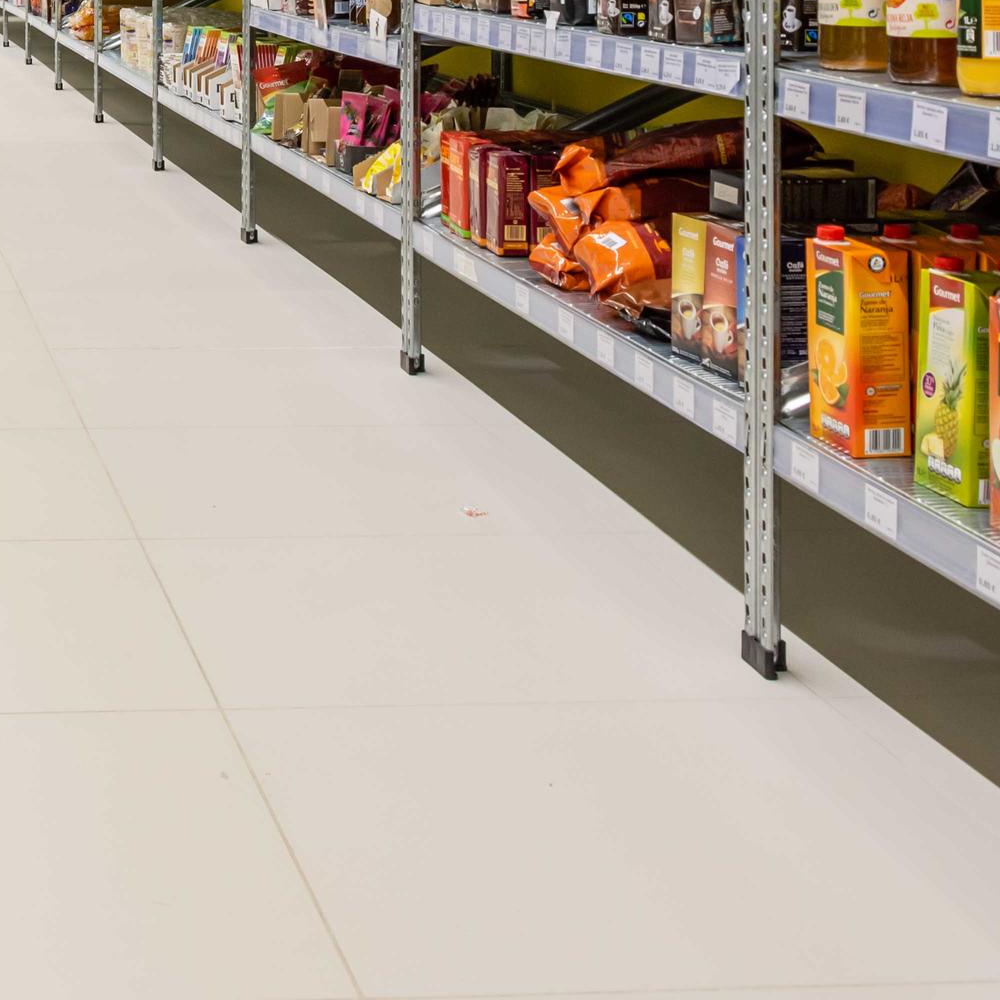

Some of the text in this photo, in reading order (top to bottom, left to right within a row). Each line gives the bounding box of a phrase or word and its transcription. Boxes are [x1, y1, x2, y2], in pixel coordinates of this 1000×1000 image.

[259, 78, 290, 90] Gourmet
[712, 235, 735, 252] Gourmet
[815, 250, 840, 267] Gourmet
[858, 290, 890, 299] Gourmet
[933, 284, 961, 303] Gourmet
[859, 304, 895, 315] Naranja
